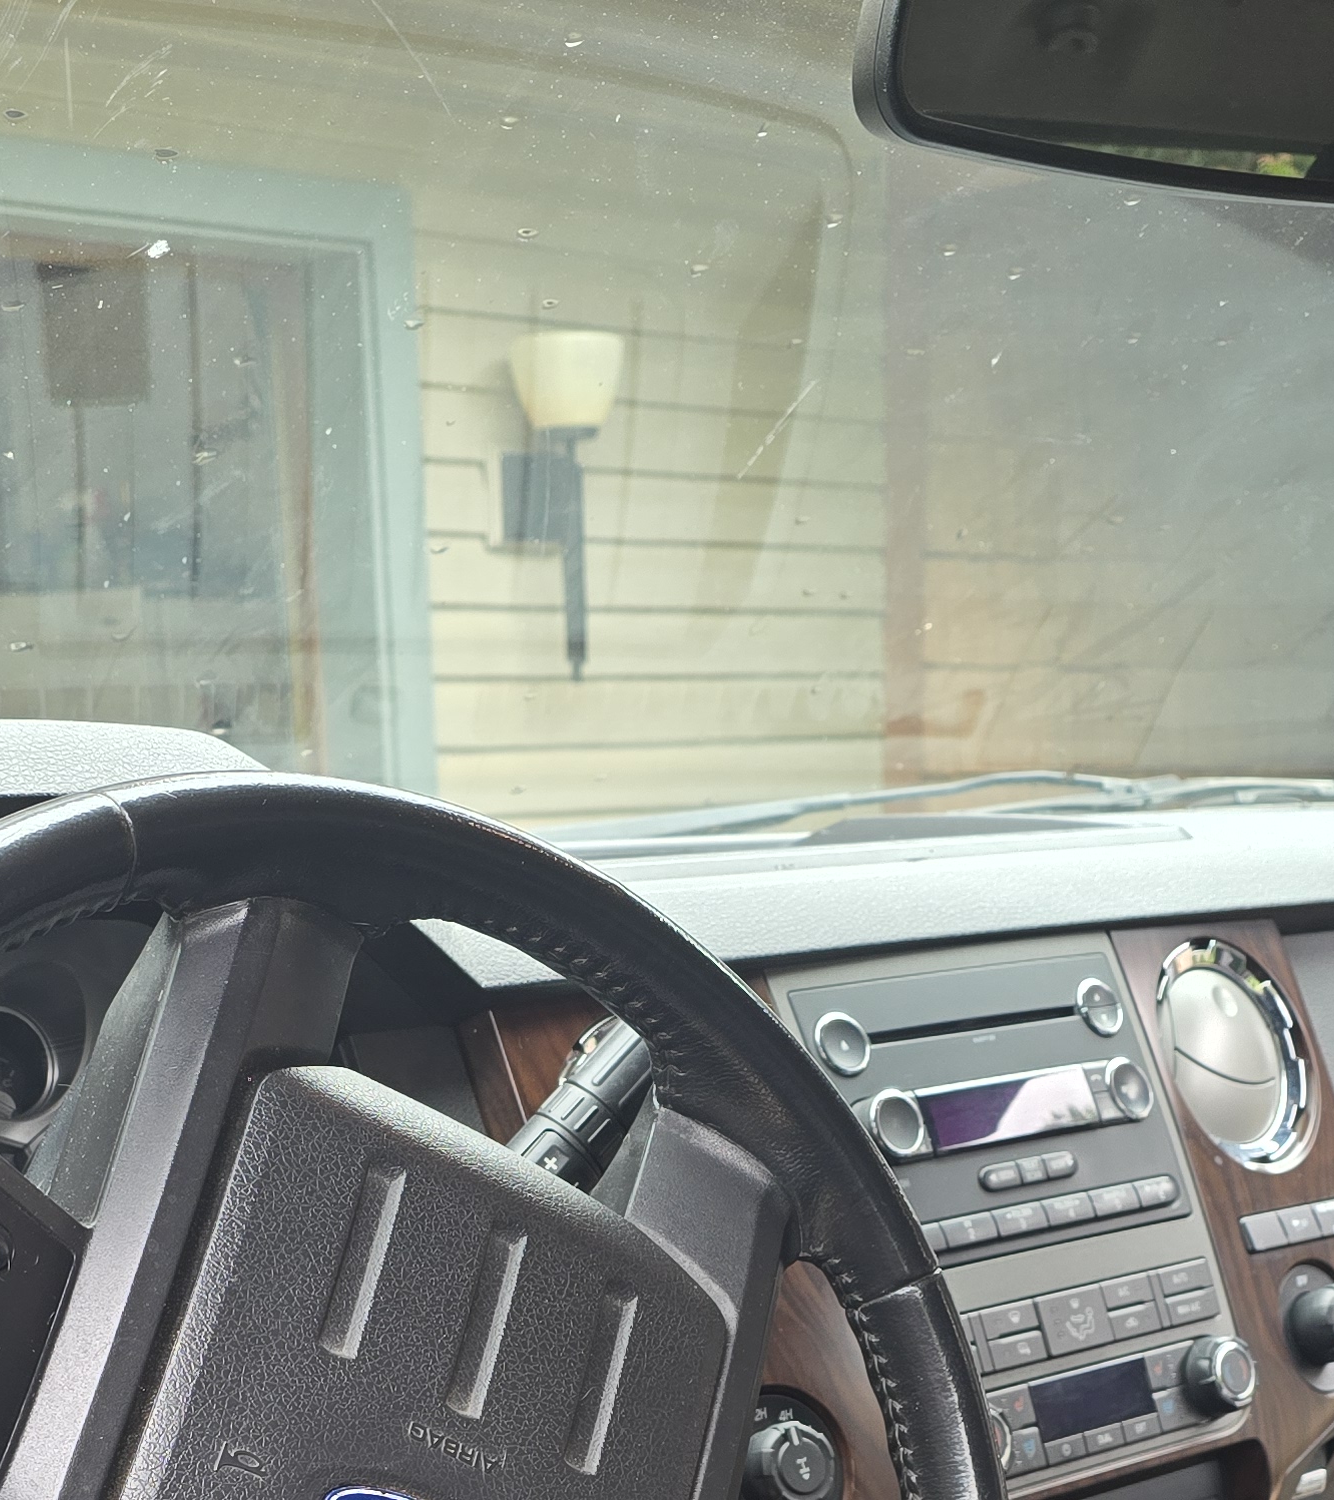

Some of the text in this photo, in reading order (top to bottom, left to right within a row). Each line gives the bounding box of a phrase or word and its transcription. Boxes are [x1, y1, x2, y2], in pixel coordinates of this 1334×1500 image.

[754, 1407, 768, 1421] 2H
[779, 1408, 793, 1421] 4H
[408, 1420, 502, 1476] AIRBAG
